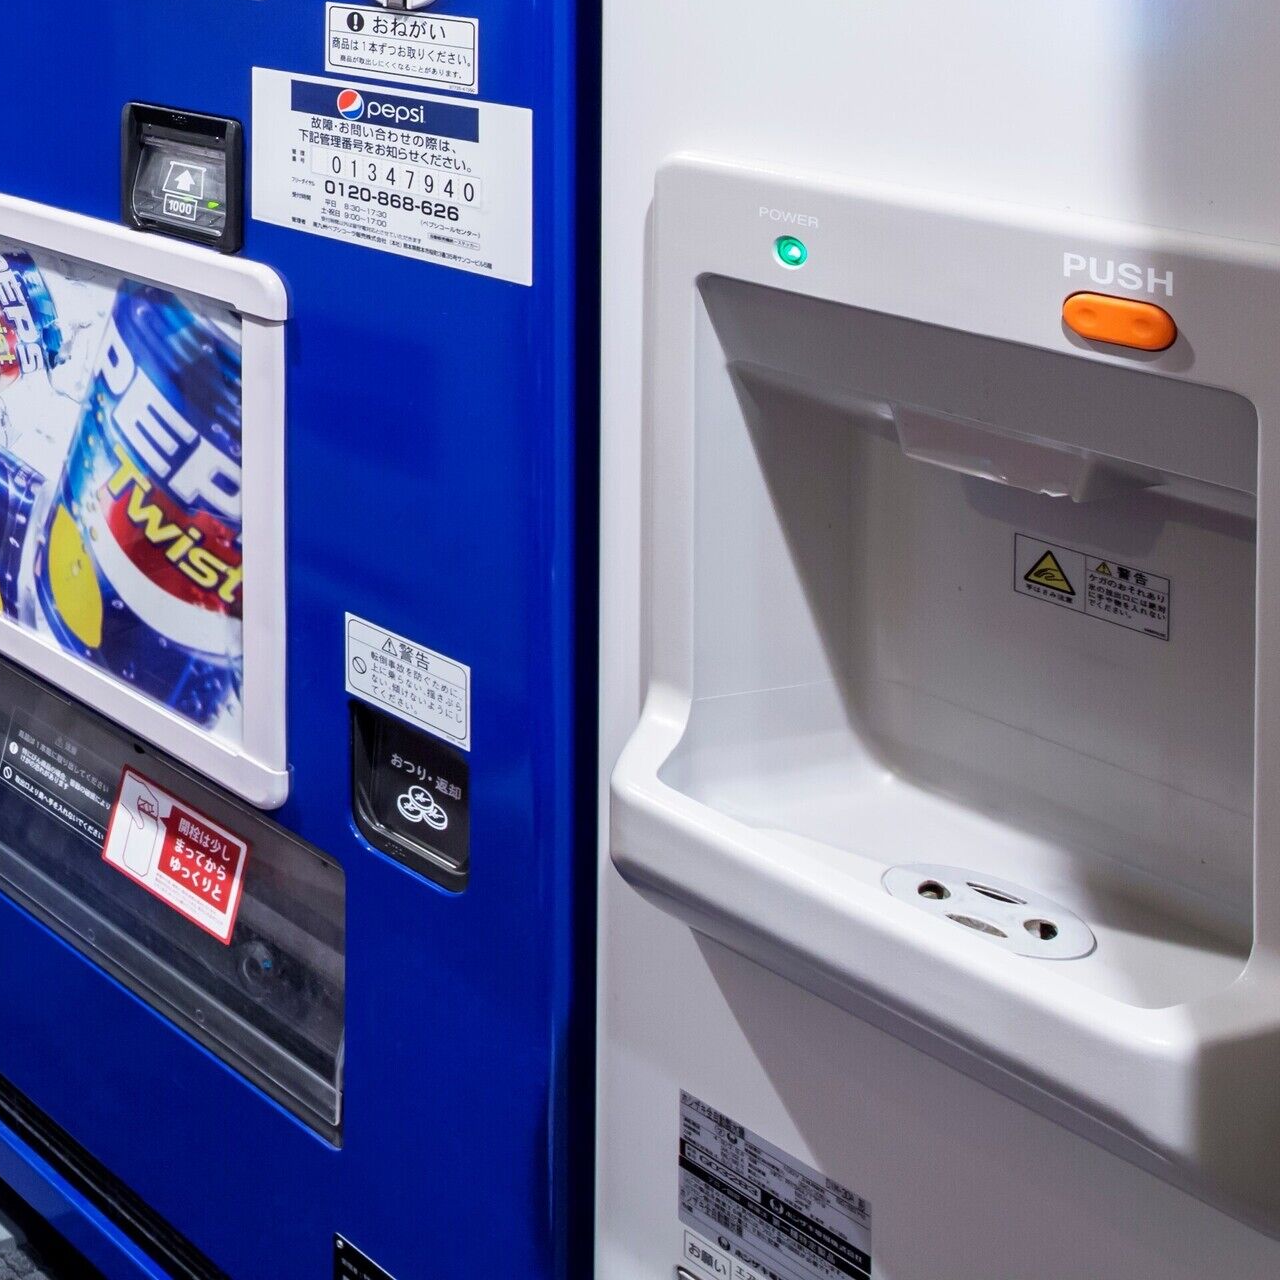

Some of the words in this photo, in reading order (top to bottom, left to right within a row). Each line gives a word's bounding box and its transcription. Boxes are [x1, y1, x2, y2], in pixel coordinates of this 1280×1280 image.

[372, 15, 447, 41] おねがい
[367, 100, 426, 124] pepsi
[168, 199, 193, 215] 1000
[324, 179, 460, 222] 0120-868-626
[324, 198, 337, 208] 平日
[758, 206, 820, 228] POWER
[1063, 252, 1174, 297] PUSH
[1117, 566, 1149, 587] 警告
[399, 642, 430, 671] 警告
[390, 752, 463, 801] おつり・返却
[177, 816, 231, 862] 開栓は少し
[173, 838, 227, 882] まってから
[168, 856, 222, 903] ゆっくりと
[687, 1241, 728, 1277] お願い
